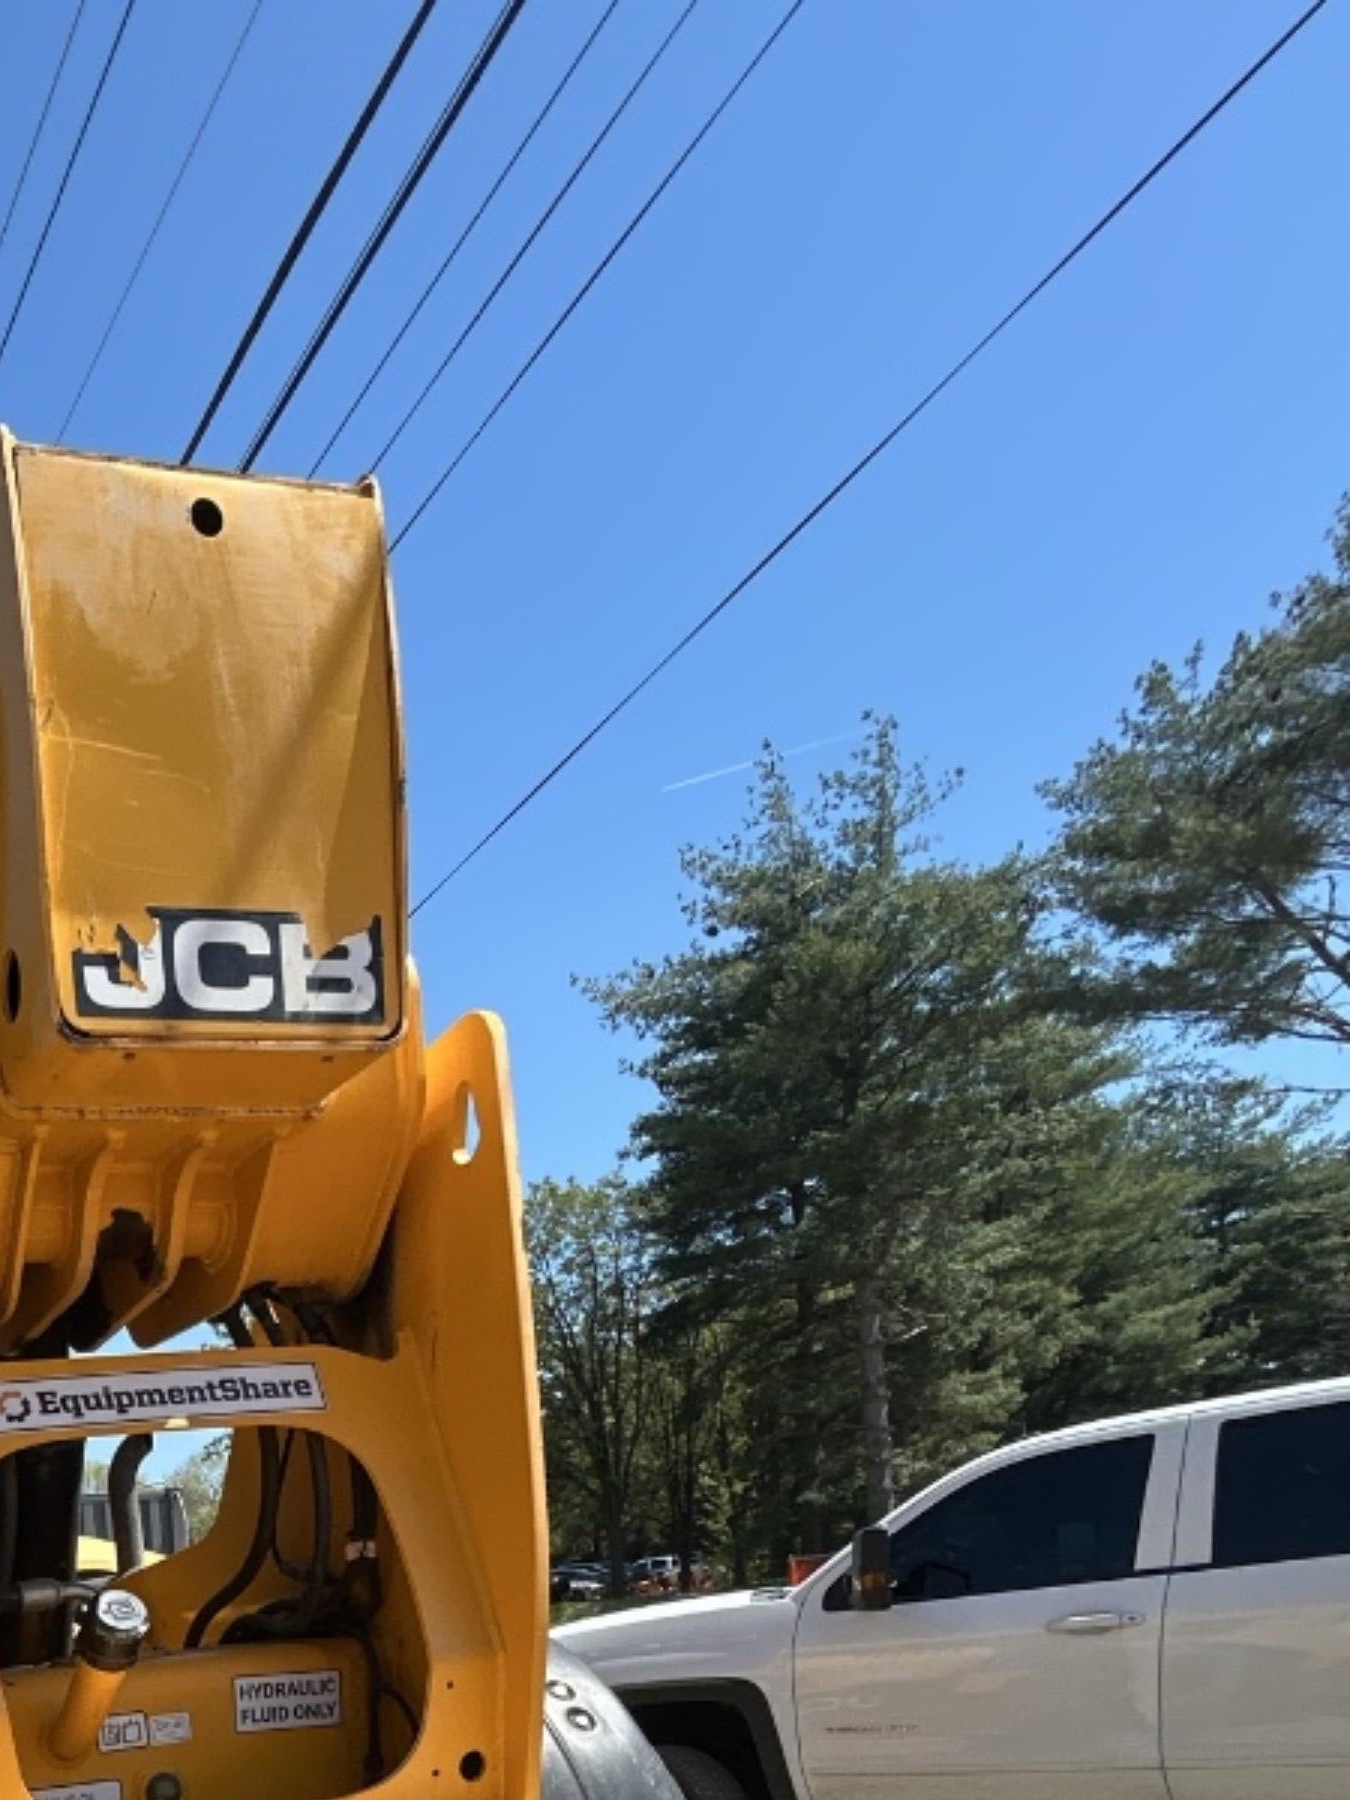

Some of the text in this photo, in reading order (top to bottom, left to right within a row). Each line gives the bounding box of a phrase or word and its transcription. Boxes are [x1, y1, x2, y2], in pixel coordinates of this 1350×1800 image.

[83, 917, 378, 1014] JCB
[35, 1378, 313, 1417] EquipmentShare
[239, 1676, 336, 1701] HYDRAULIC
[240, 1700, 337, 1725] FLUID ONLY
